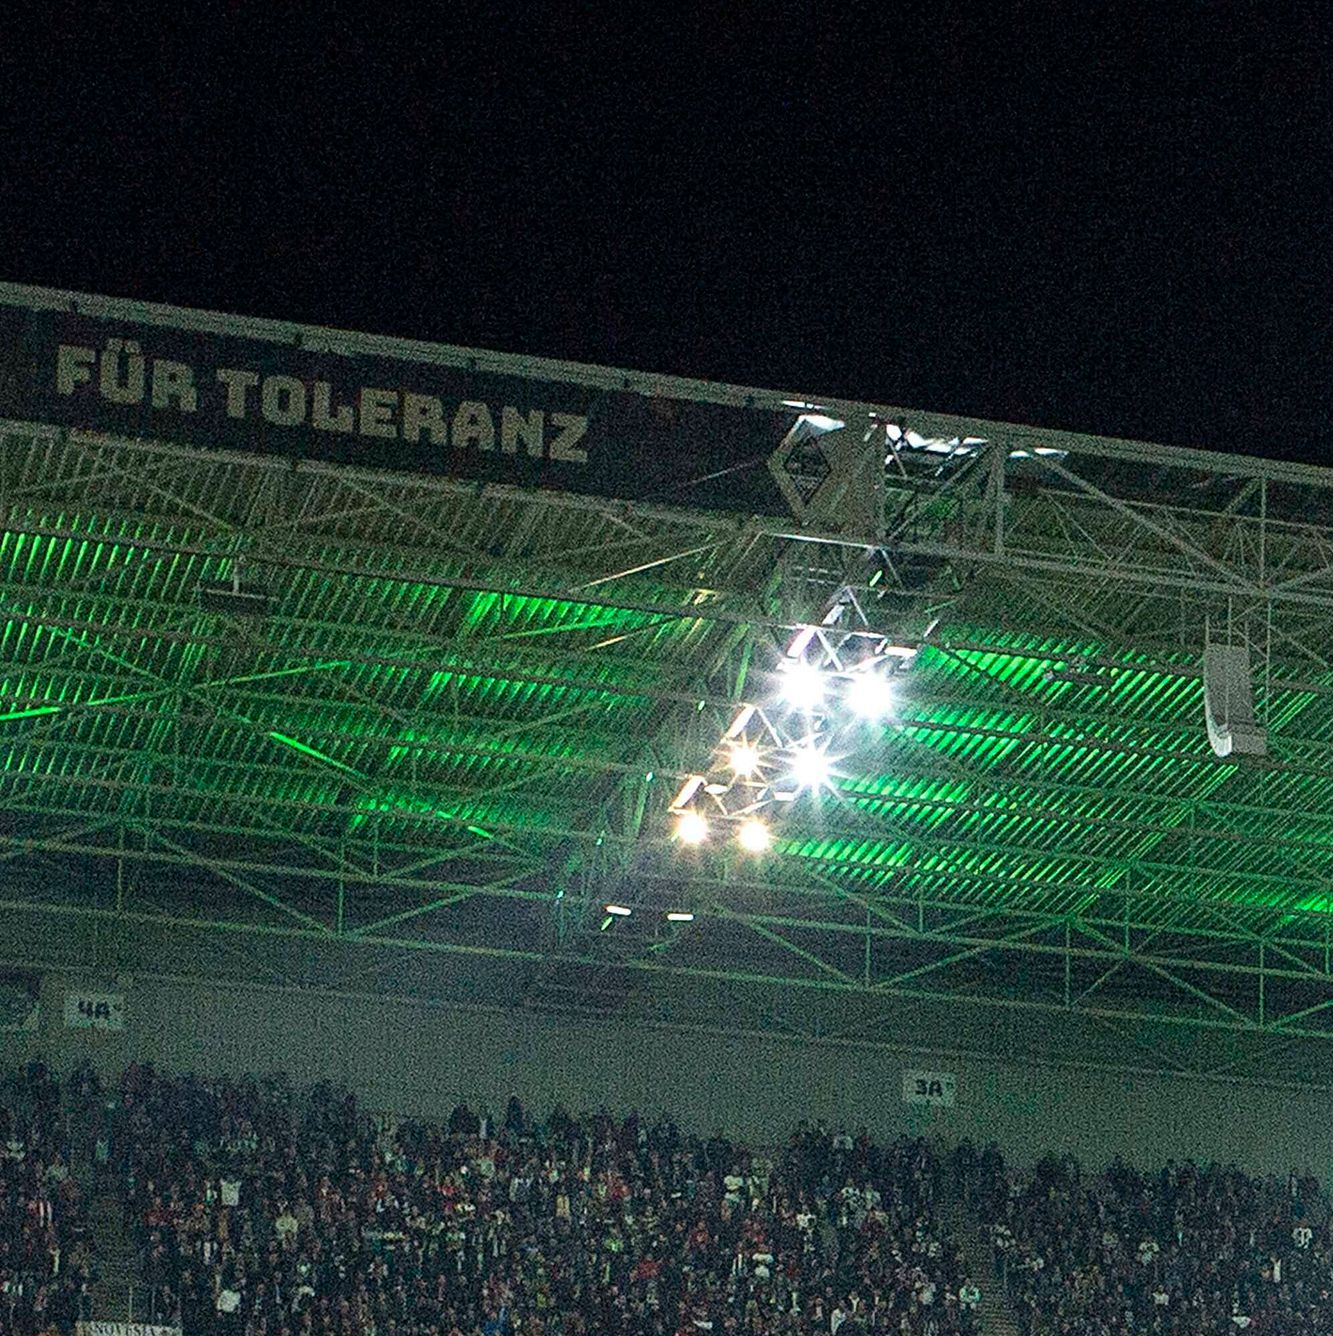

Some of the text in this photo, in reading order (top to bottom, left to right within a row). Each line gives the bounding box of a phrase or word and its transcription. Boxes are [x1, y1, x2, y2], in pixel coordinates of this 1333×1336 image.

[57, 338, 588, 463] FÜR TOLERANZ
[915, 1079, 943, 1097] 3A
